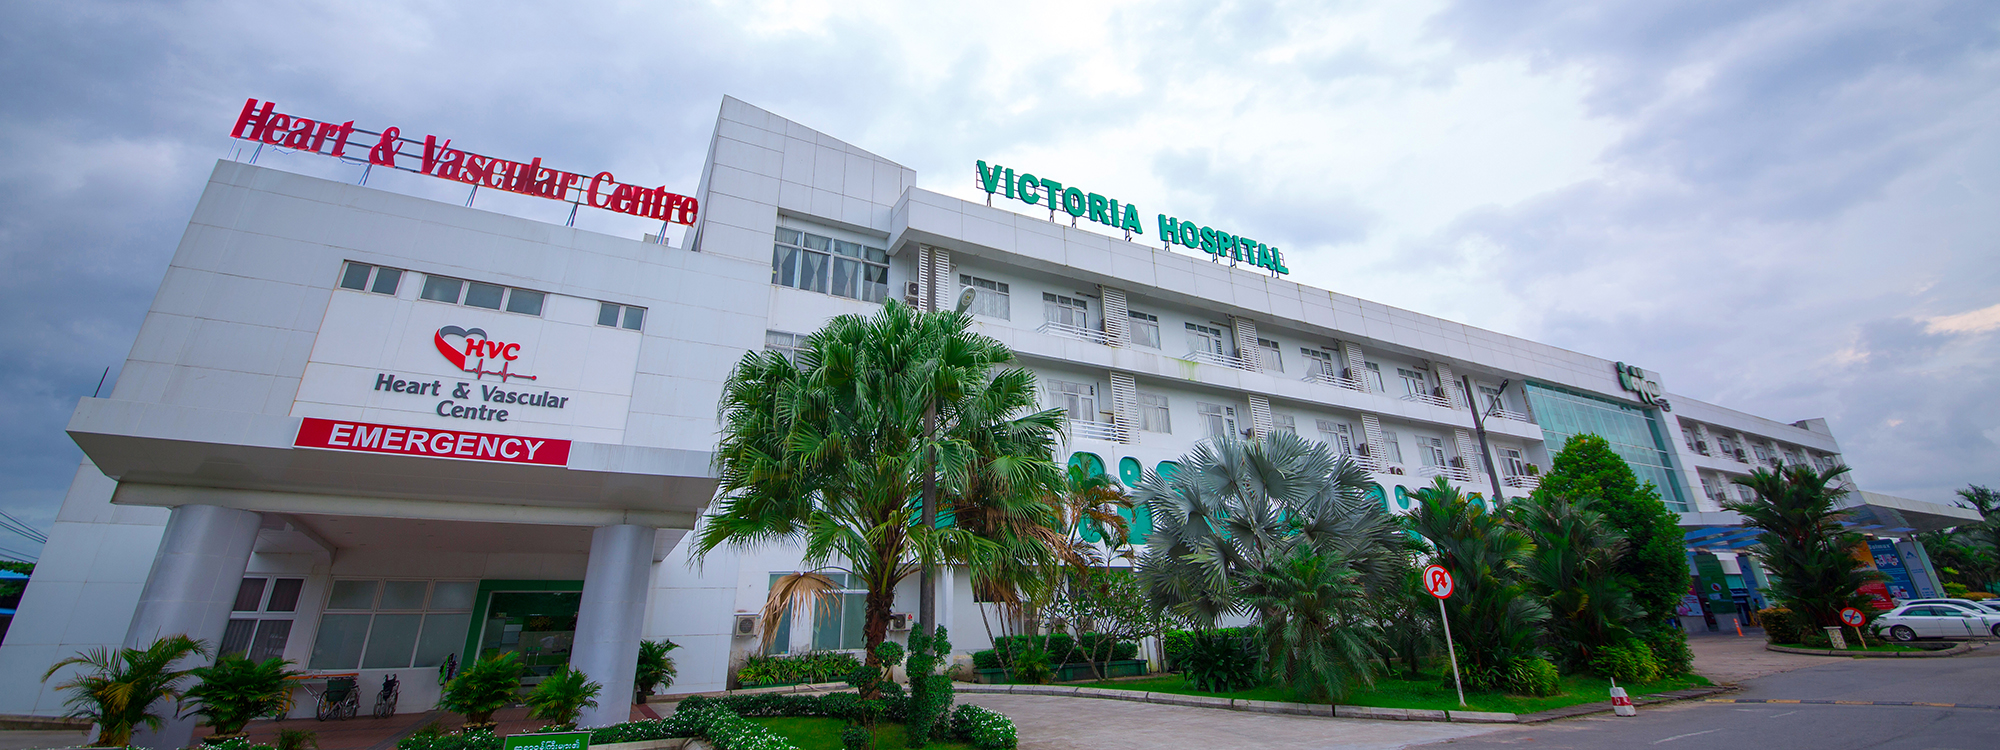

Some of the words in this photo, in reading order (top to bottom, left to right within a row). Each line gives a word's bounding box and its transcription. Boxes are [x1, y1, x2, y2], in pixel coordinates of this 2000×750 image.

[230, 98, 354, 157] Heart
[369, 126, 403, 167] &
[420, 135, 578, 201] Vascular
[587, 172, 698, 227] Centre
[977, 160, 1143, 234] VICTORIA
[1158, 214, 1289, 274] HOSPITAL
[465, 338, 521, 361] HVC
[374, 374, 441, 397] Heart
[452, 382, 471, 401] &
[481, 386, 569, 410] Vascular
[436, 401, 509, 423] Centre
[328, 424, 544, 459] EMERGENCY
